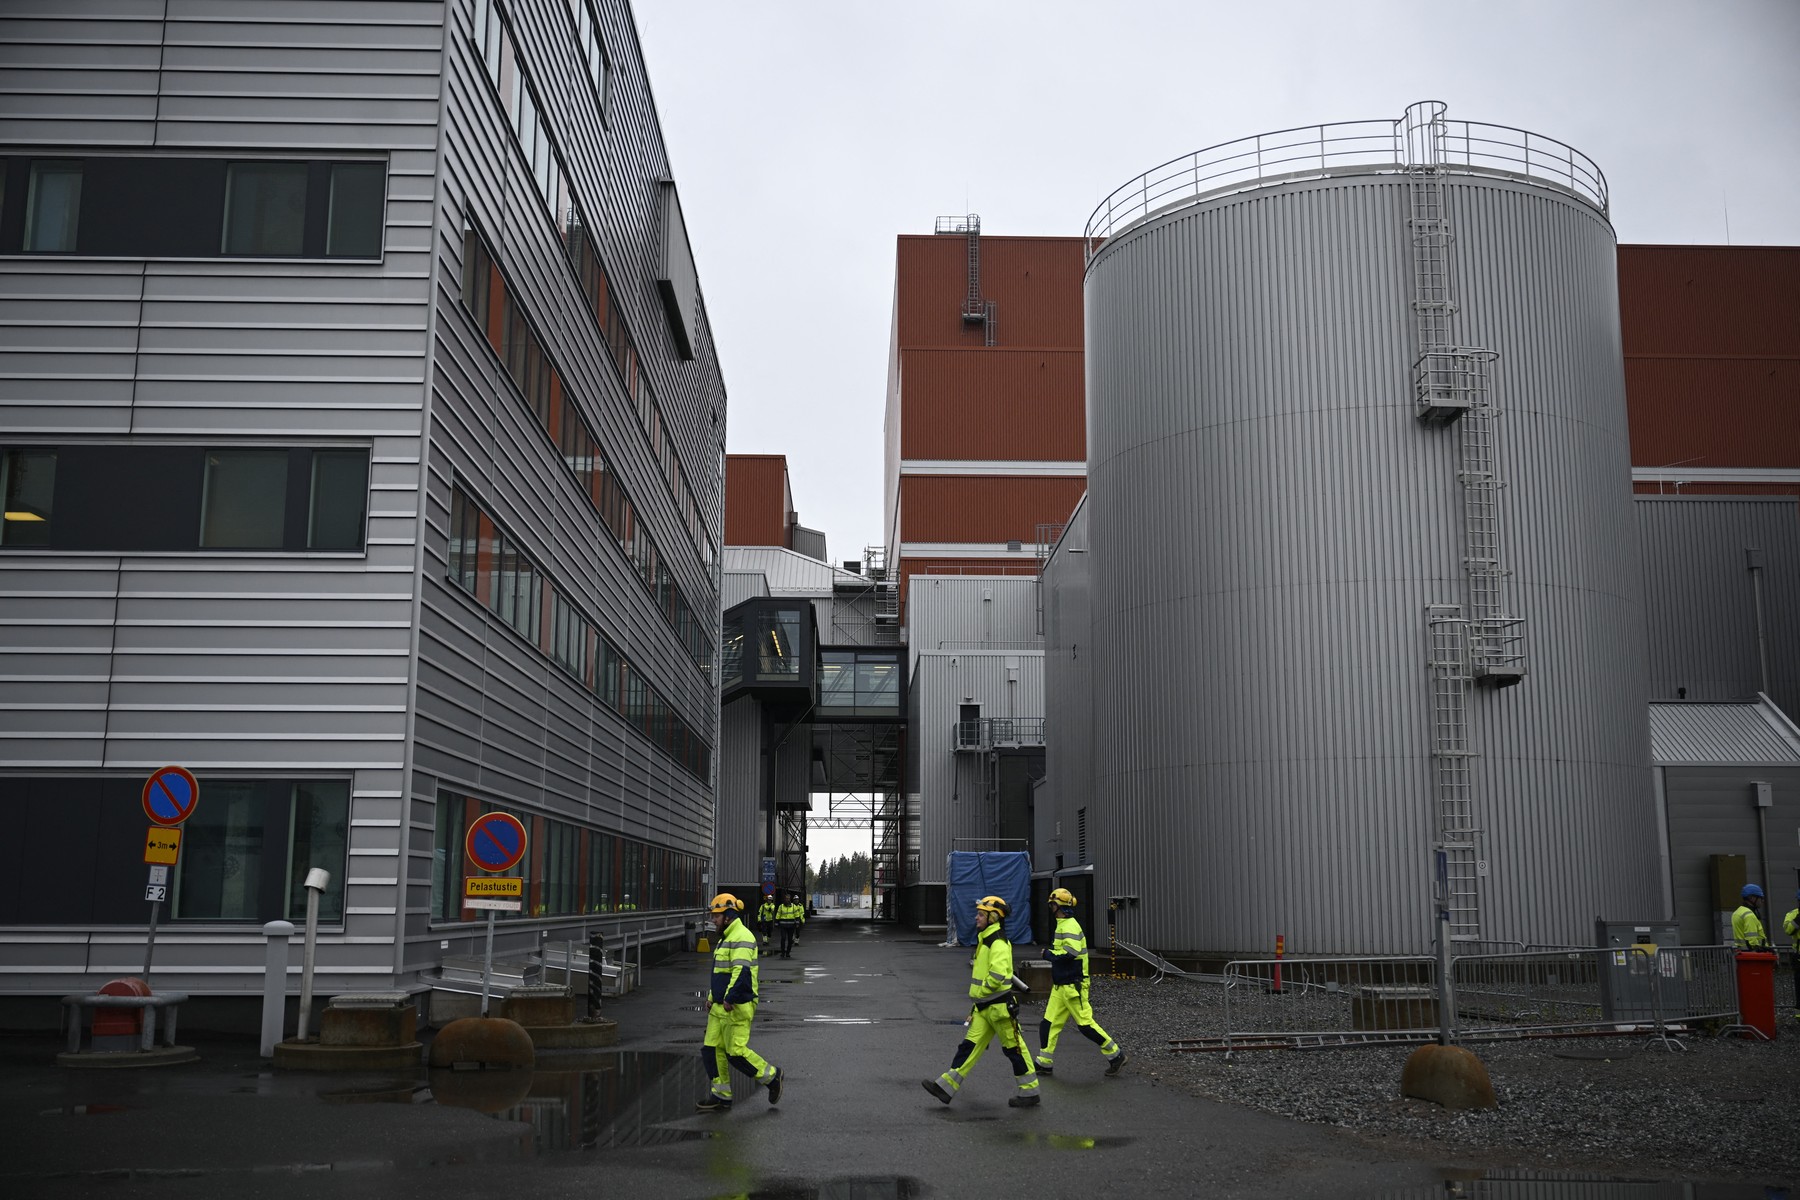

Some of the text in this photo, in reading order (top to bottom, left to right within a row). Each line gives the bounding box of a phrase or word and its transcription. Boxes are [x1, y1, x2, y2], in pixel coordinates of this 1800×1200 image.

[157, 842, 168, 850] 3m
[470, 882, 517, 891] Pelastustie
[146, 887, 165, 900] F 2
